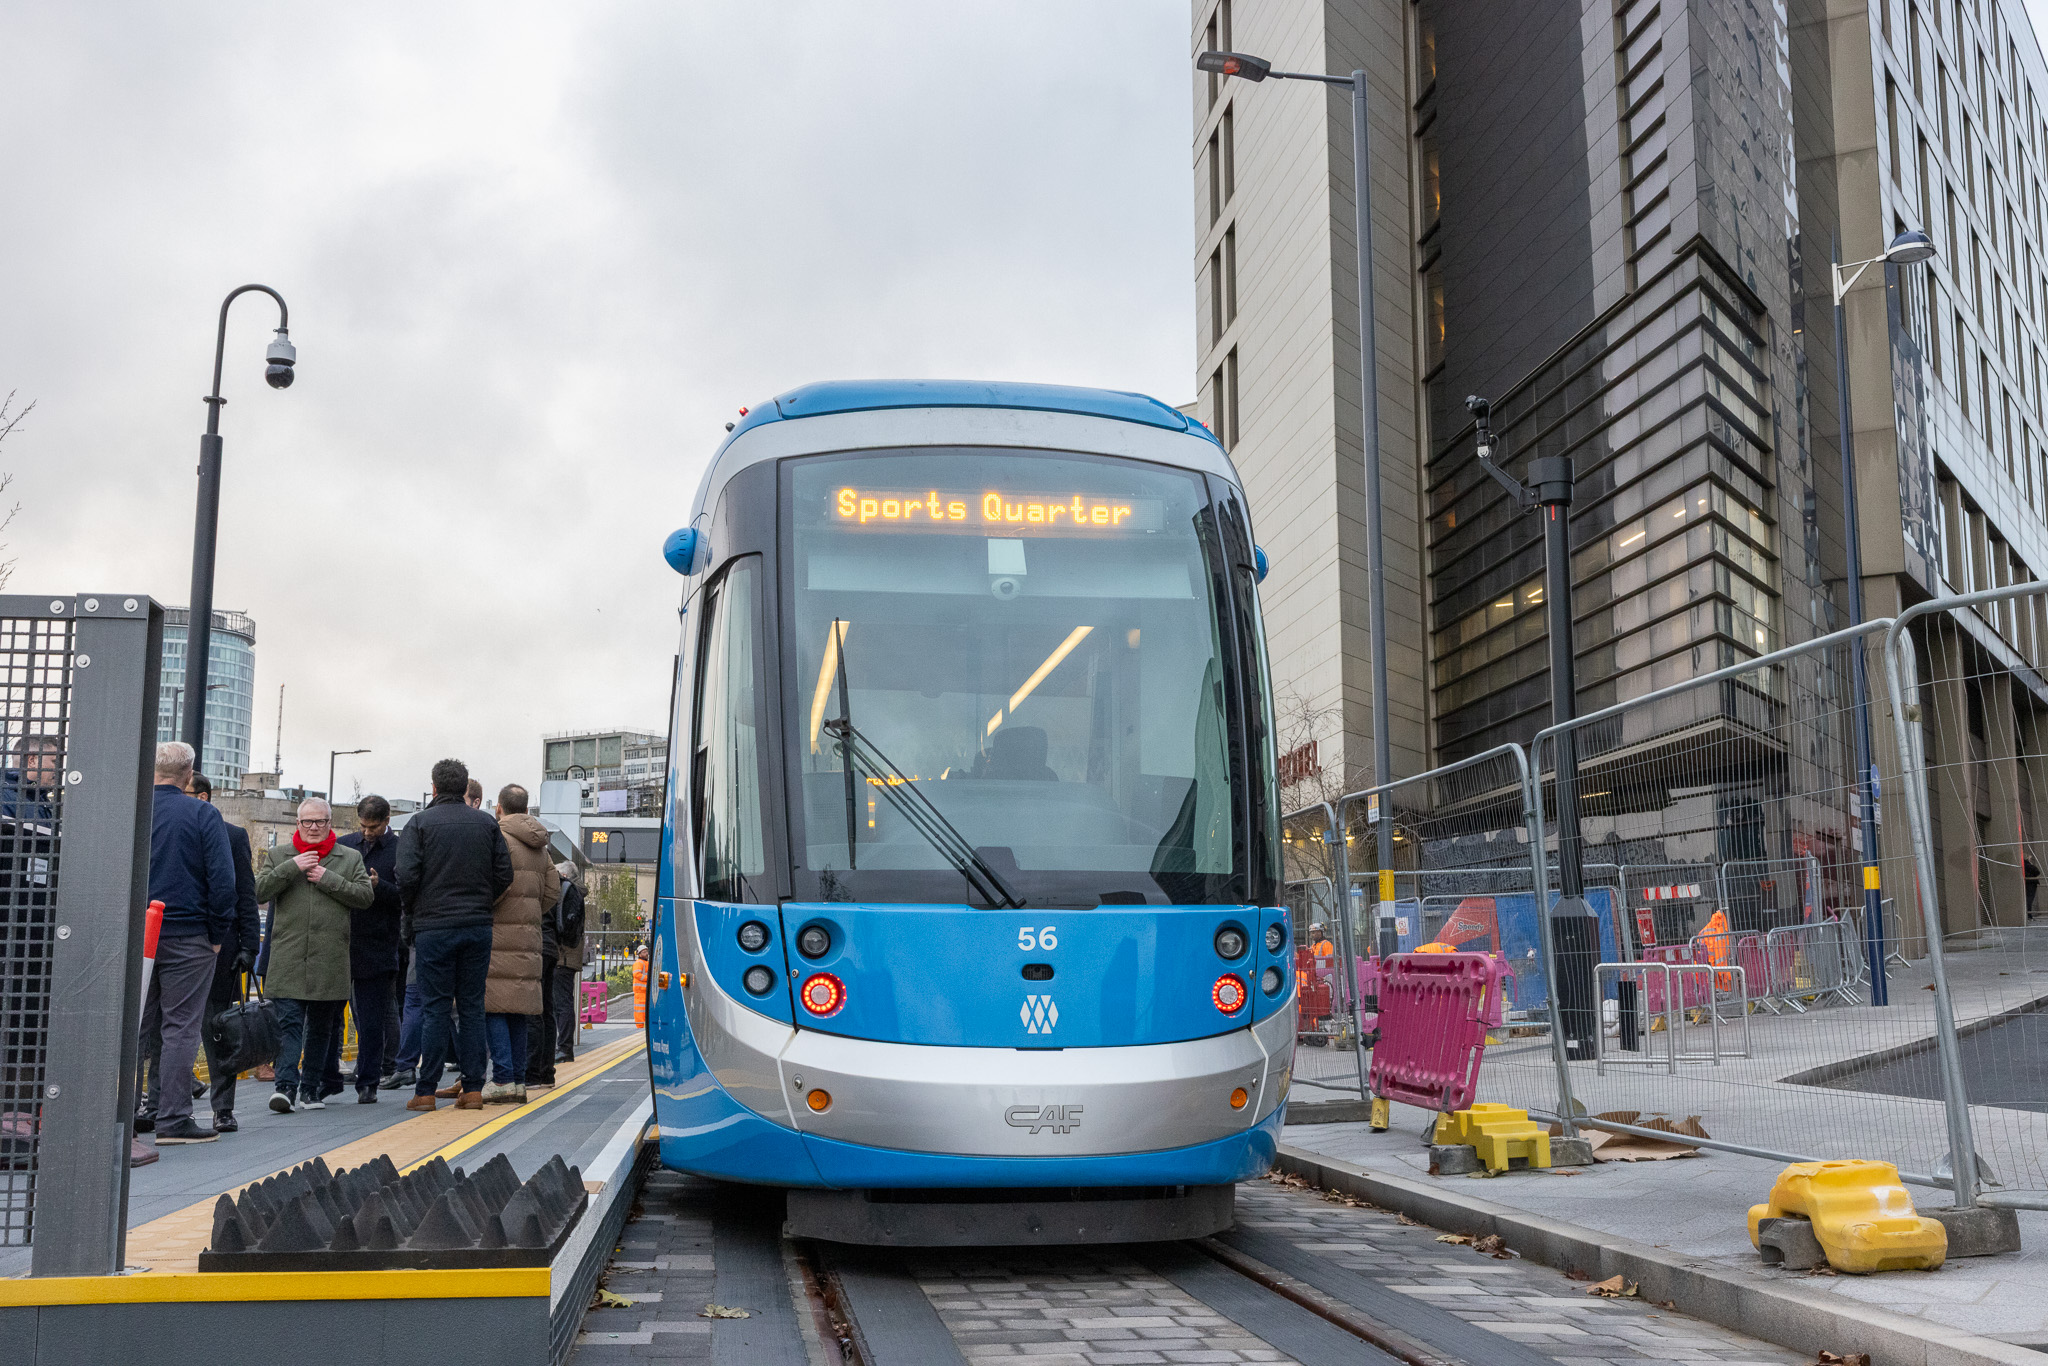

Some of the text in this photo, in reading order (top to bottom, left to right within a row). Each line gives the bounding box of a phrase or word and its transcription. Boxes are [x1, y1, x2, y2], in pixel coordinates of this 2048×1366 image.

[837, 488, 1131, 525] Sports Quarter
[1017, 926, 1058, 951] 56
[1458, 921, 1484, 932] Speedy
[1004, 1105, 1084, 1134] CAF
